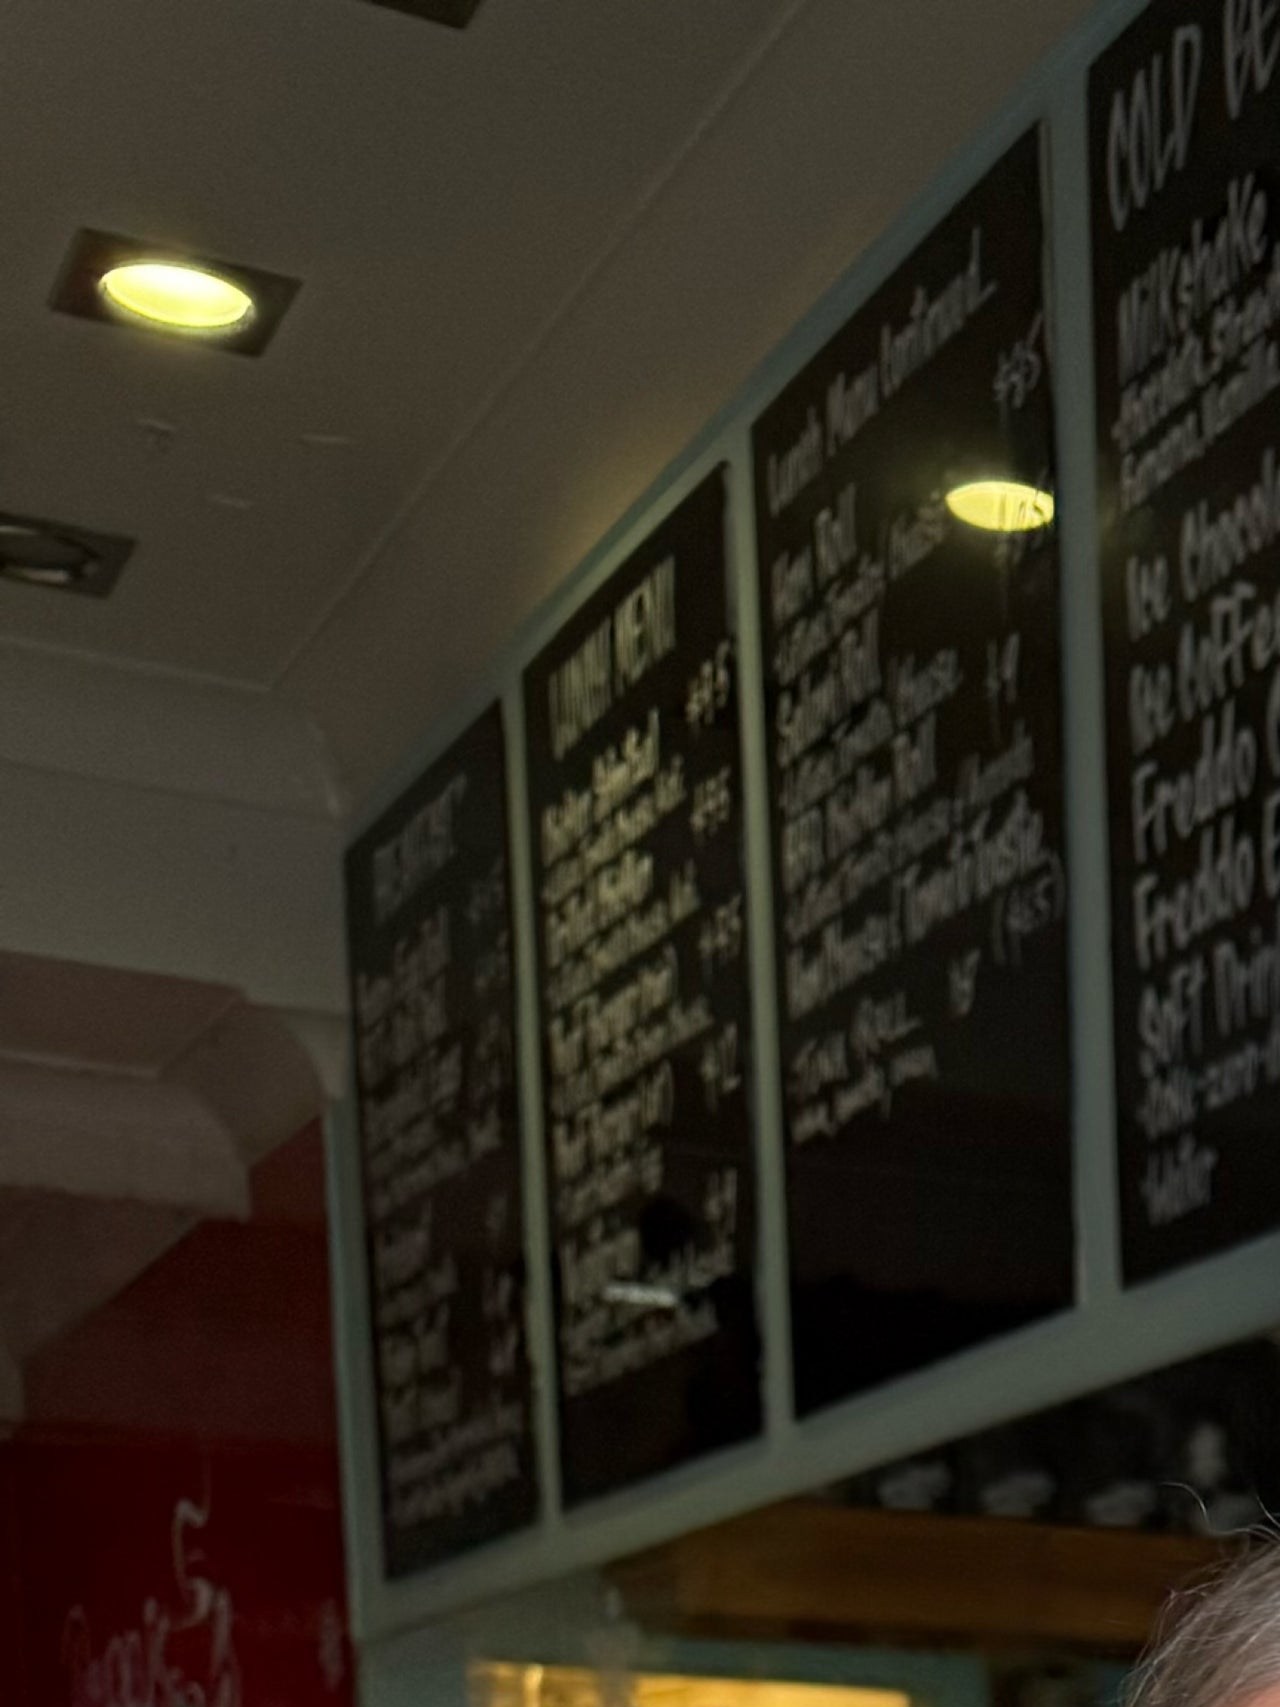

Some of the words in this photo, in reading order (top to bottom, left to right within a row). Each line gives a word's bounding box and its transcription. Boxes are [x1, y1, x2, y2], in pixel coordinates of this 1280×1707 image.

[1108, 24, 1201, 232] COLD
[1132, 698, 1258, 863] Freddo
[1134, 813, 1255, 971] Freddo
